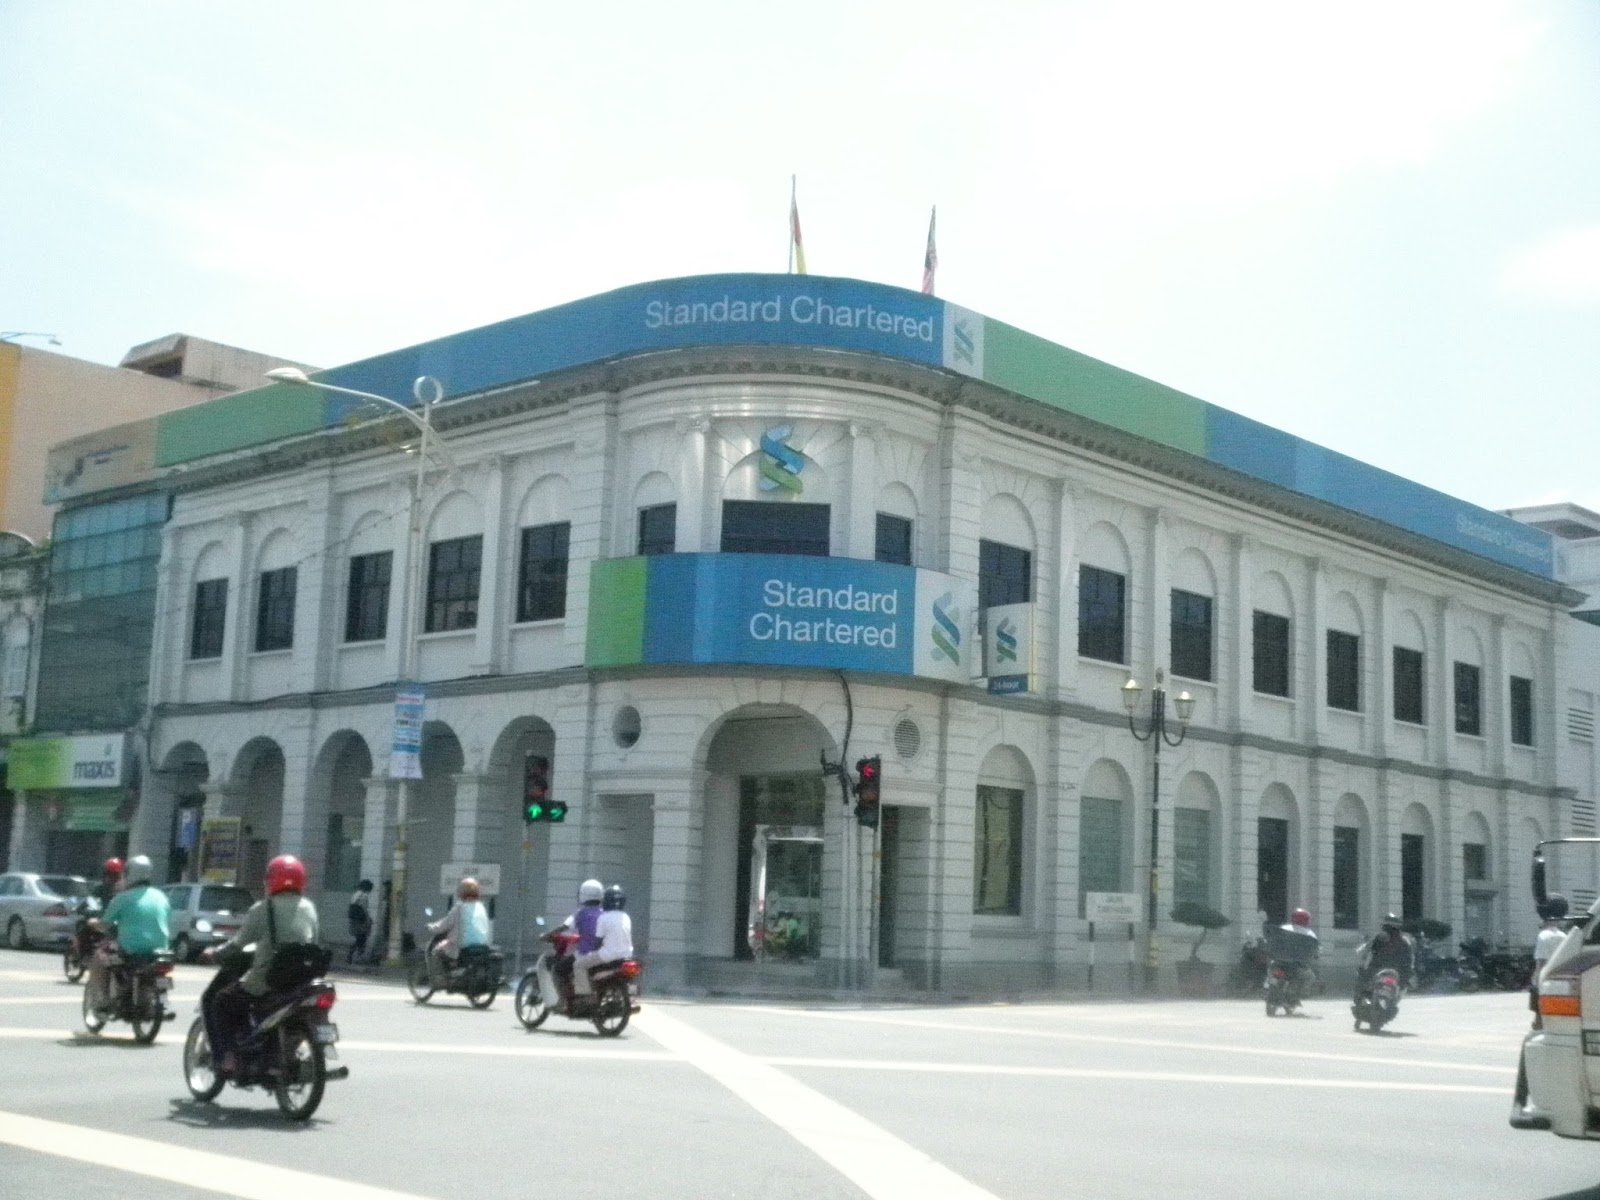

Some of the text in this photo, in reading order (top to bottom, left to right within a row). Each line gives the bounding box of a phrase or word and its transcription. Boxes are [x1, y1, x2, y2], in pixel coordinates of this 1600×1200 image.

[644, 294, 934, 342] Standard Chartered
[763, 578, 898, 615] Standard
[749, 612, 896, 649] Chartered
[73, 760, 116, 779] maxis
